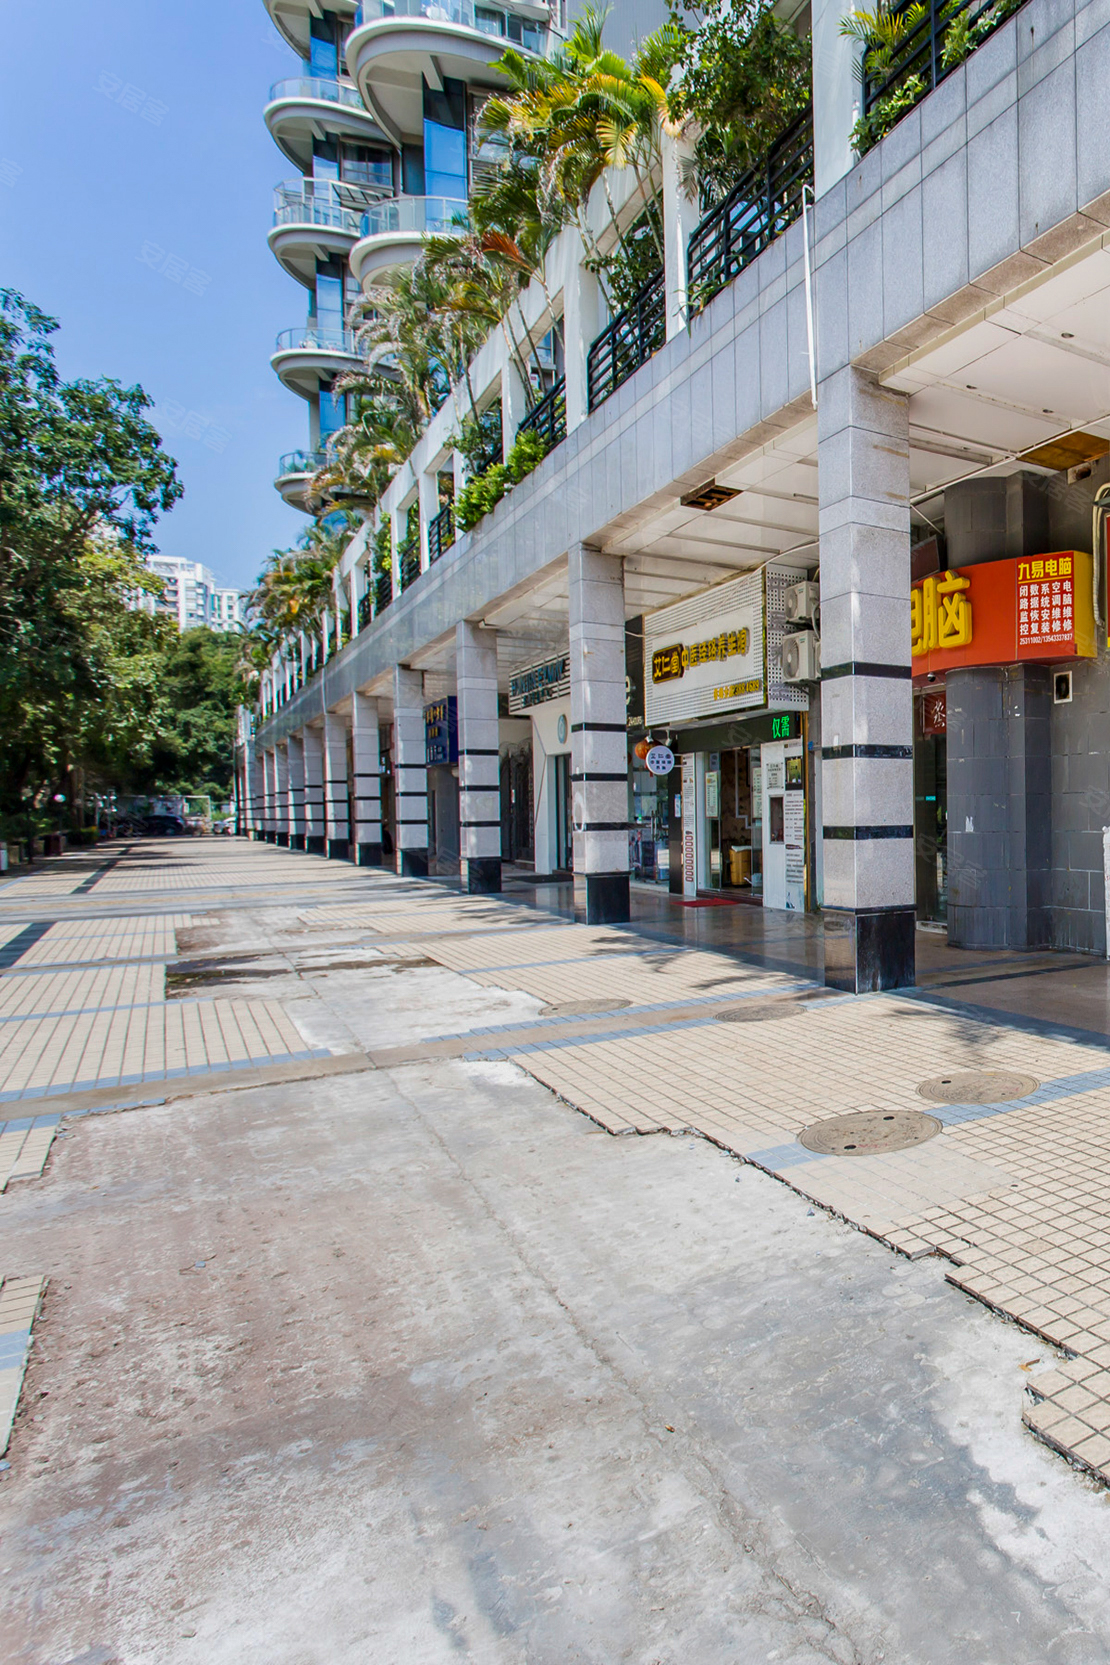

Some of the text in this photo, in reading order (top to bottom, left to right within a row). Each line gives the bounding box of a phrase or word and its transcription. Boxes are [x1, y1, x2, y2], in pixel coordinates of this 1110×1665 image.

[1018, 557, 1072, 581] 九易电脑
[772, 715, 790, 739] 仅需
